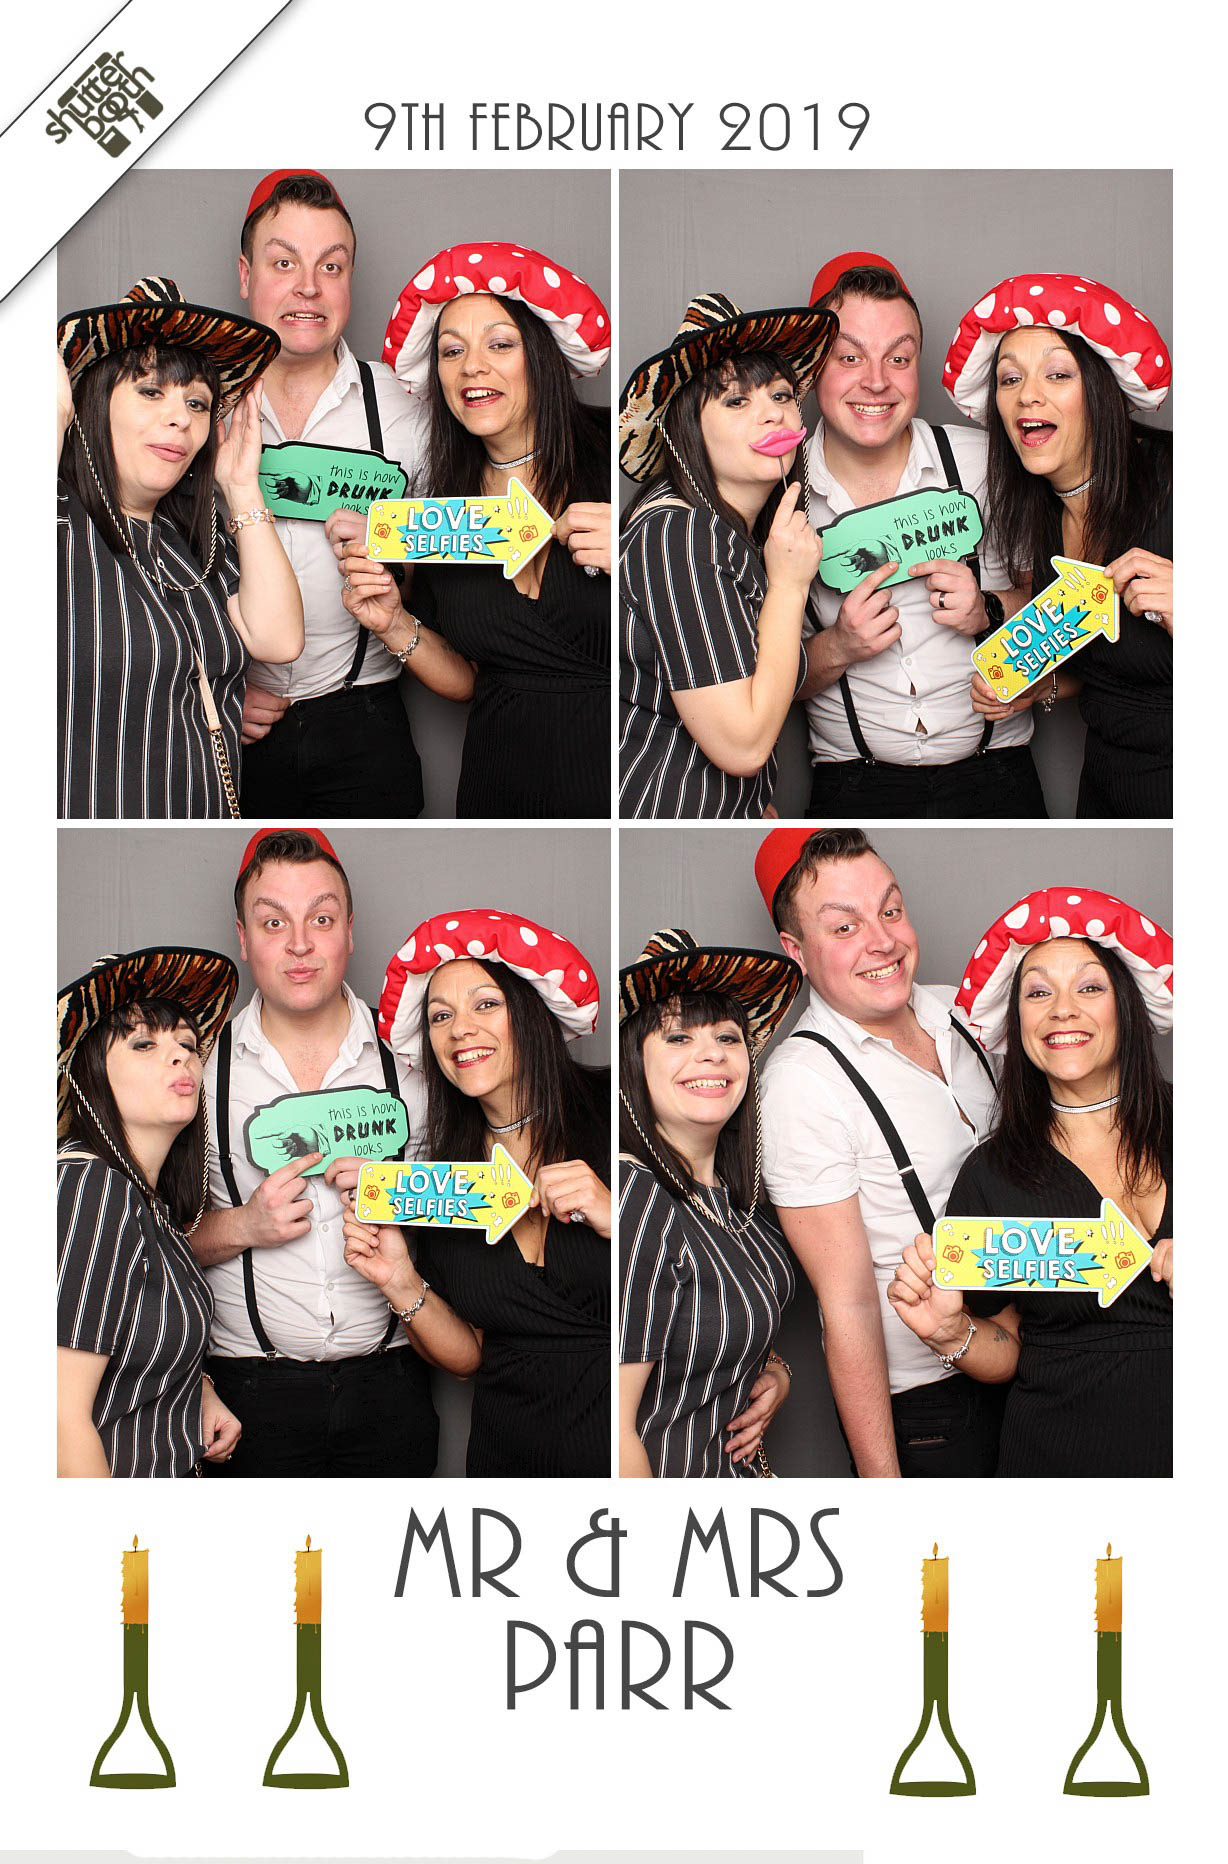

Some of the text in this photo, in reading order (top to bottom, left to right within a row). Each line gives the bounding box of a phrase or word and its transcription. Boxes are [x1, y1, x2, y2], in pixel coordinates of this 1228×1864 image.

[330, 465, 402, 485] this is how
[327, 481, 394, 500] DRUNK
[408, 505, 484, 531] LOVE
[894, 498, 968, 530] this is how
[405, 533, 484, 553] SELFIES
[901, 515, 970, 550] DRUNK
[925, 543, 958, 561] looks
[1001, 598, 1066, 659] LOVE
[1016, 622, 1080, 677] SELFIES
[328, 1101, 397, 1120] this is how
[333, 1119, 397, 1142] DRUNK
[353, 1142, 383, 1156] looks
[395, 1170, 469, 1195] LOVE
[393, 1197, 469, 1217] SELFIES
[984, 1228, 1075, 1256] LOVE
[982, 1259, 1076, 1280] SELFIES
